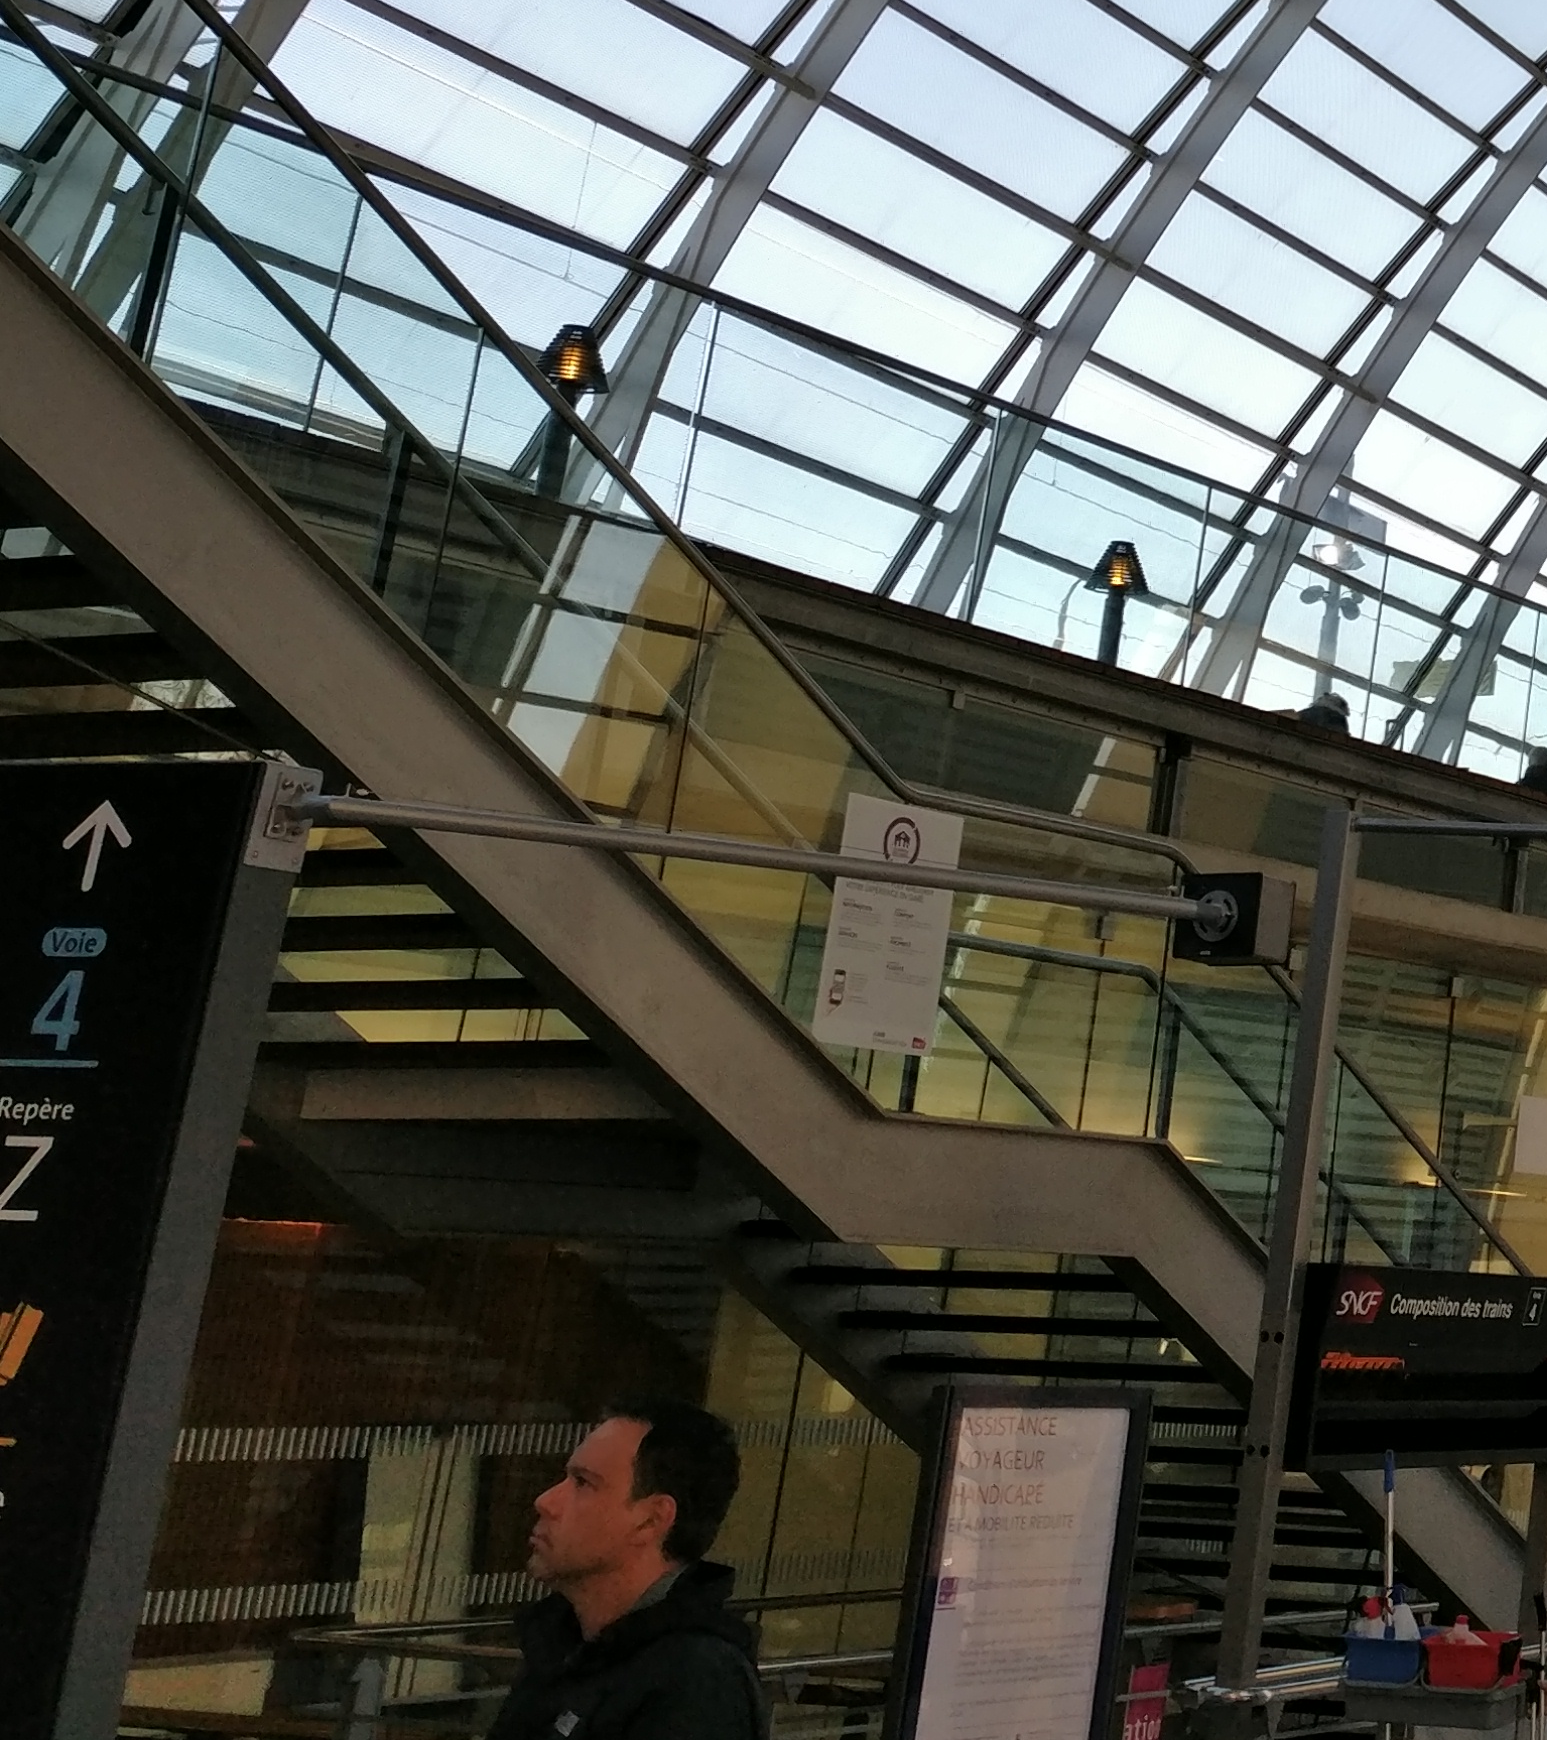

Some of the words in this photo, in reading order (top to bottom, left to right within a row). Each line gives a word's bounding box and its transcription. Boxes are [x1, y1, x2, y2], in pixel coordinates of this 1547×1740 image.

[52, 930, 98, 953] Voie
[30, 970, 86, 1052] 4
[0, 1096, 75, 1126] Repère
[0, 1135, 55, 1222] Z
[1336, 1290, 1382, 1316] SNCF
[1391, 1293, 1460, 1320] Composition
[1460, 1302, 1481, 1318] des
[1482, 1299, 1513, 1320] trains
[962, 1417, 1057, 1436] ASSISTANCE
[959, 1450, 1045, 1469] VOYAGEUR
